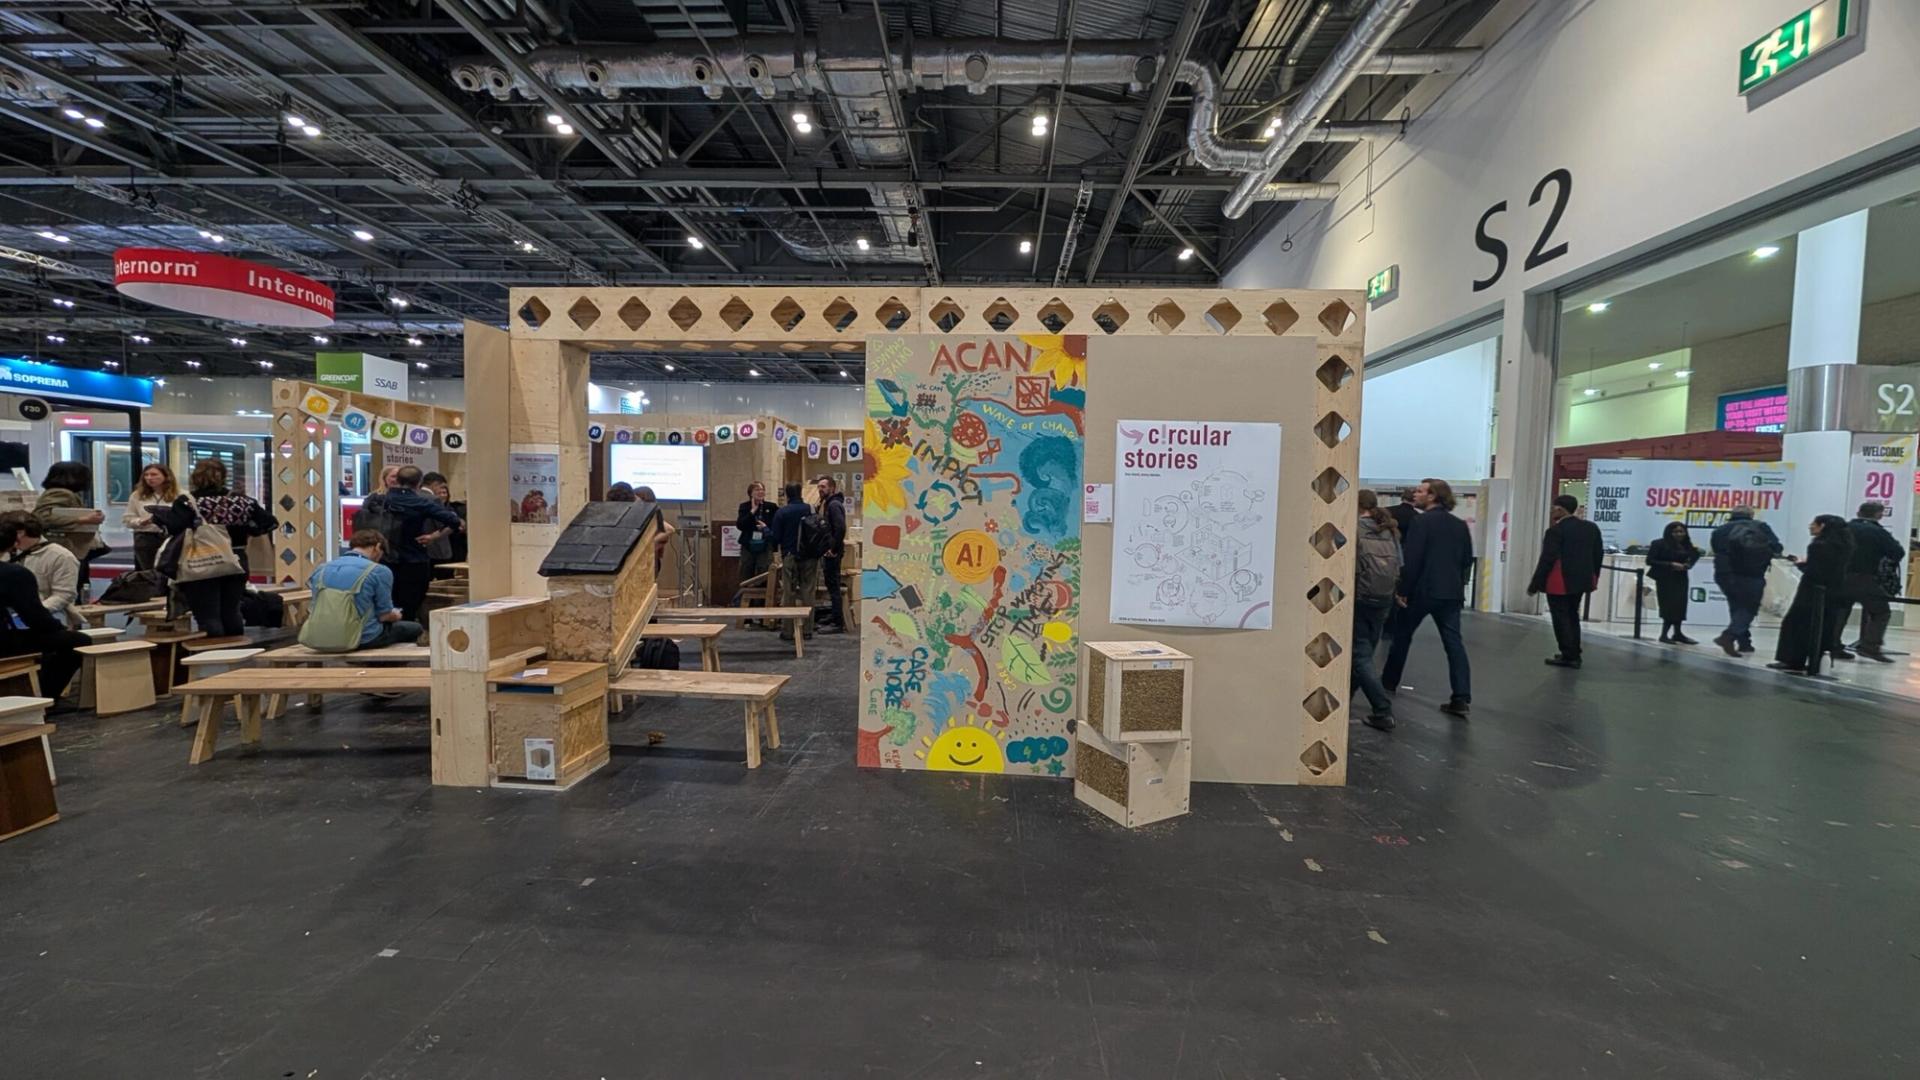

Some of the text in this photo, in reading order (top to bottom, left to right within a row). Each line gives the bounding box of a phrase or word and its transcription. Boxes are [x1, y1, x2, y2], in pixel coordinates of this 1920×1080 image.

[115, 259, 198, 277] nternorm
[249, 270, 334, 311] Internorm
[930, 340, 1032, 376] ACAN
[14, 373, 69, 389] SOPREMA
[375, 377, 398, 390] SSAB
[1877, 383, 1914, 415] S2
[350, 416, 361, 426] A!
[982, 404, 1015, 429] WAVE
[384, 426, 394, 436] A!
[414, 432, 425, 441] A!
[449, 436, 459, 445] A!
[1124, 447, 1198, 469] stories
[1863, 446, 1905, 457] WELCOME
[913, 438, 983, 506] IMPACT
[1596, 486, 1630, 498] COLLECT
[1865, 471, 1894, 498] 20
[1595, 499, 1618, 510] YOUR
[1646, 487, 1783, 510] SUSTAINABILITY
[1594, 511, 1622, 522] BADGE
[1688, 511, 1731, 527] IMPAC
[956, 543, 983, 567] A!
[980, 605, 1011, 649] STOP
[905, 646, 929, 693] CARE
[884, 655, 906, 710] MORE
